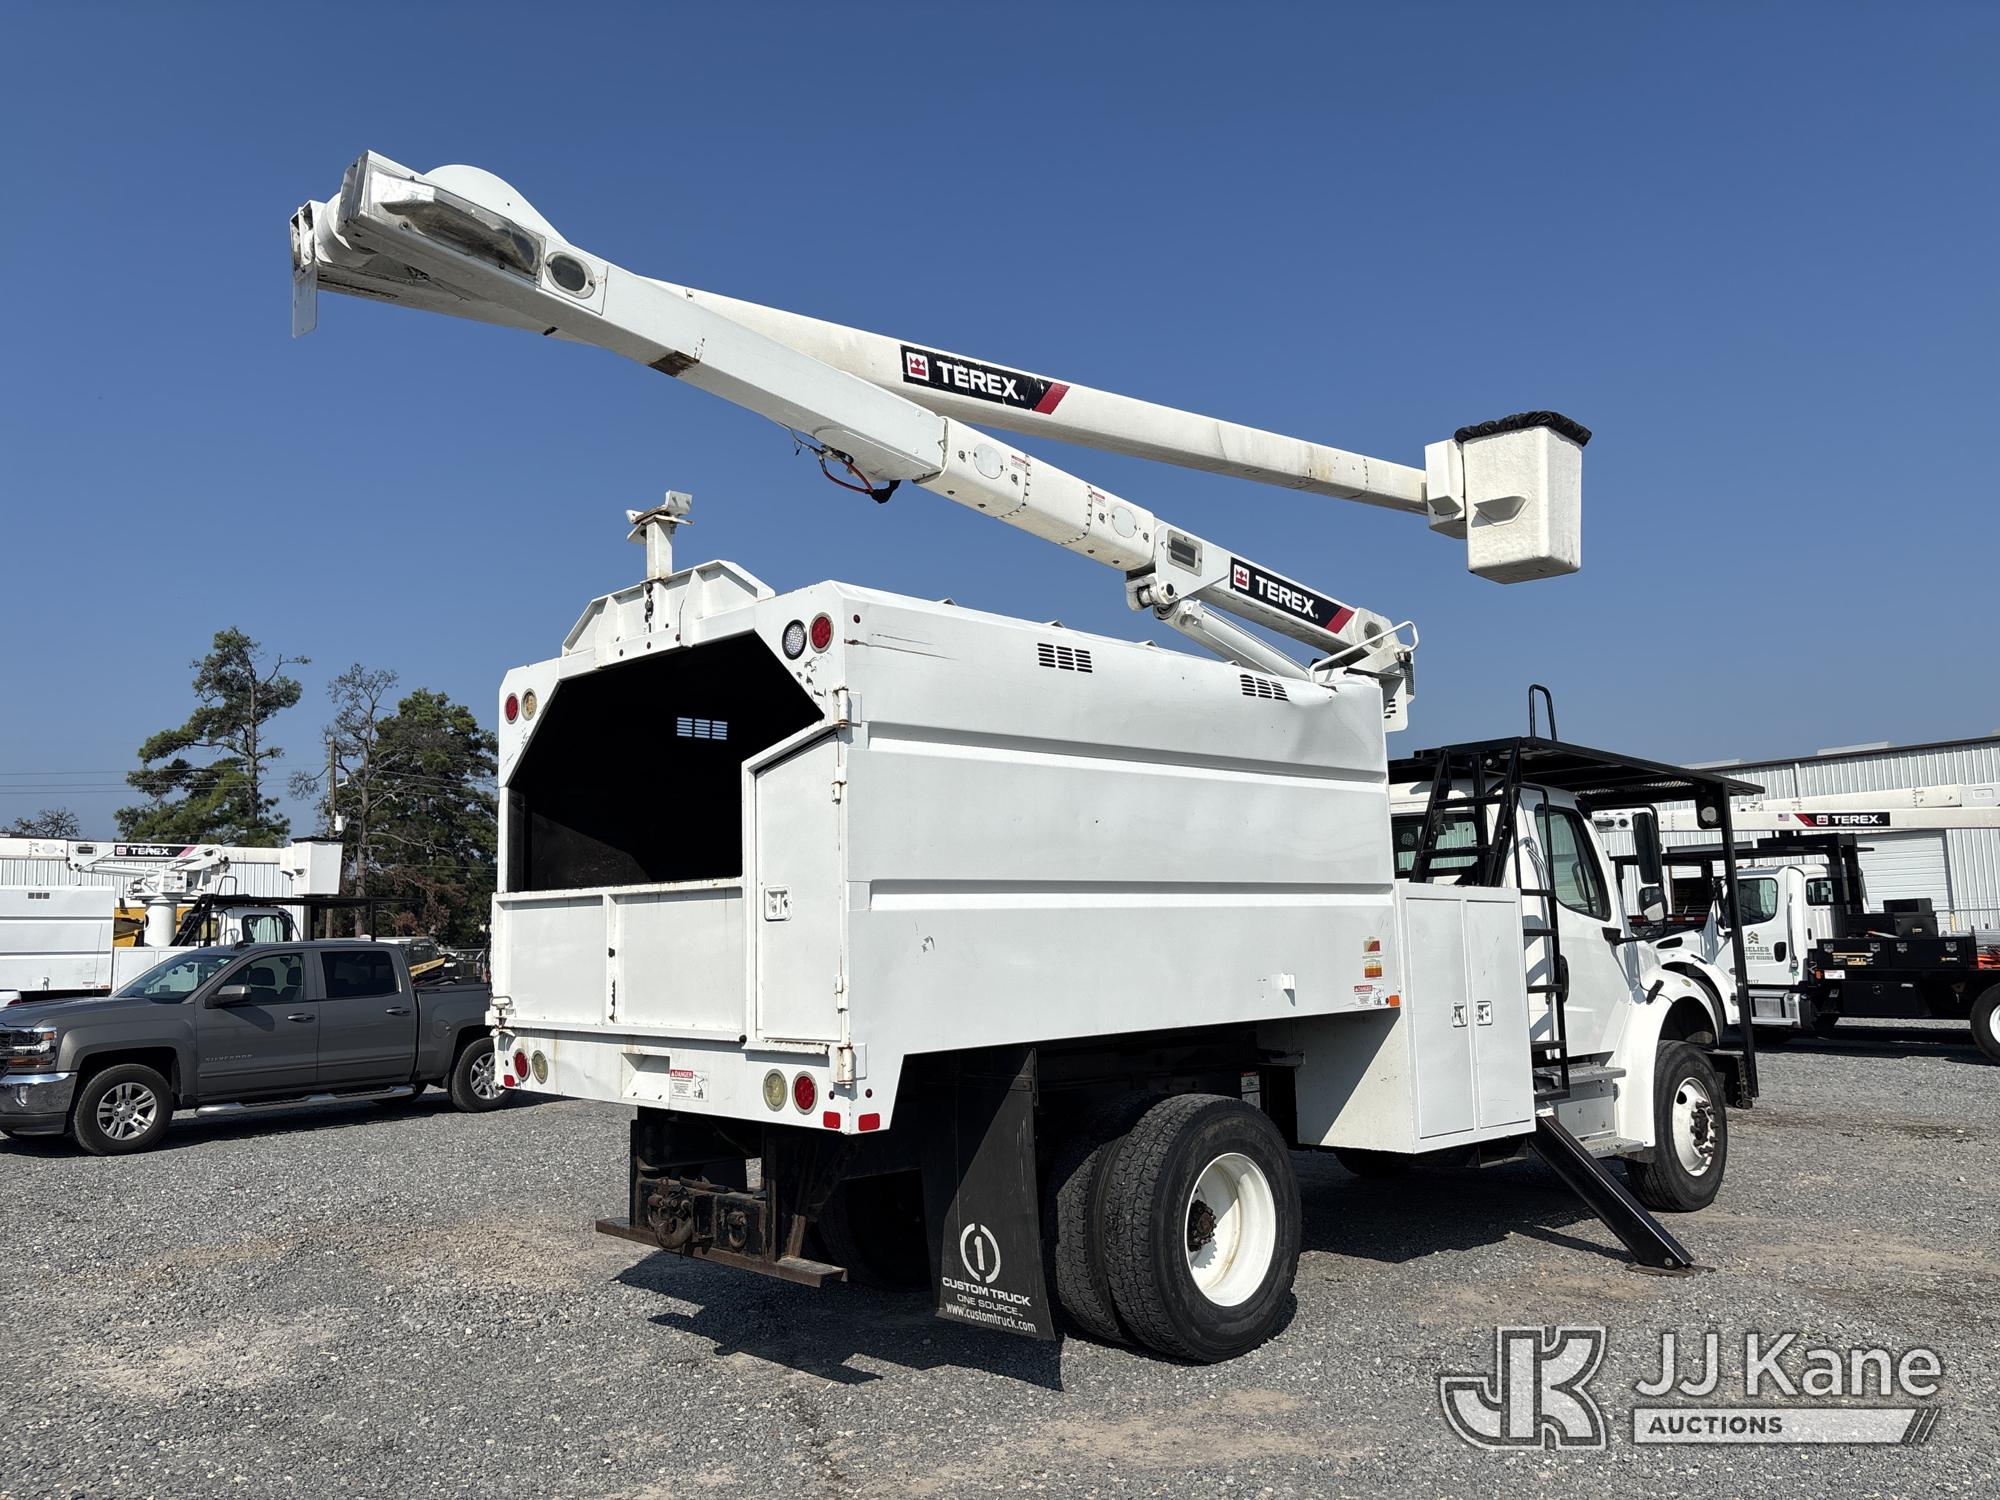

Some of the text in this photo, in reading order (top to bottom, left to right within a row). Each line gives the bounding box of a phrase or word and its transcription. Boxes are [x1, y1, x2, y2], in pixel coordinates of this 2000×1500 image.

[674, 1070, 693, 1078] DANGER
[942, 1276, 1032, 1307] CUSTOM TRUCK
[957, 1293, 976, 1306] ONE
[945, 1302, 1037, 1333] www.customtruck.com
